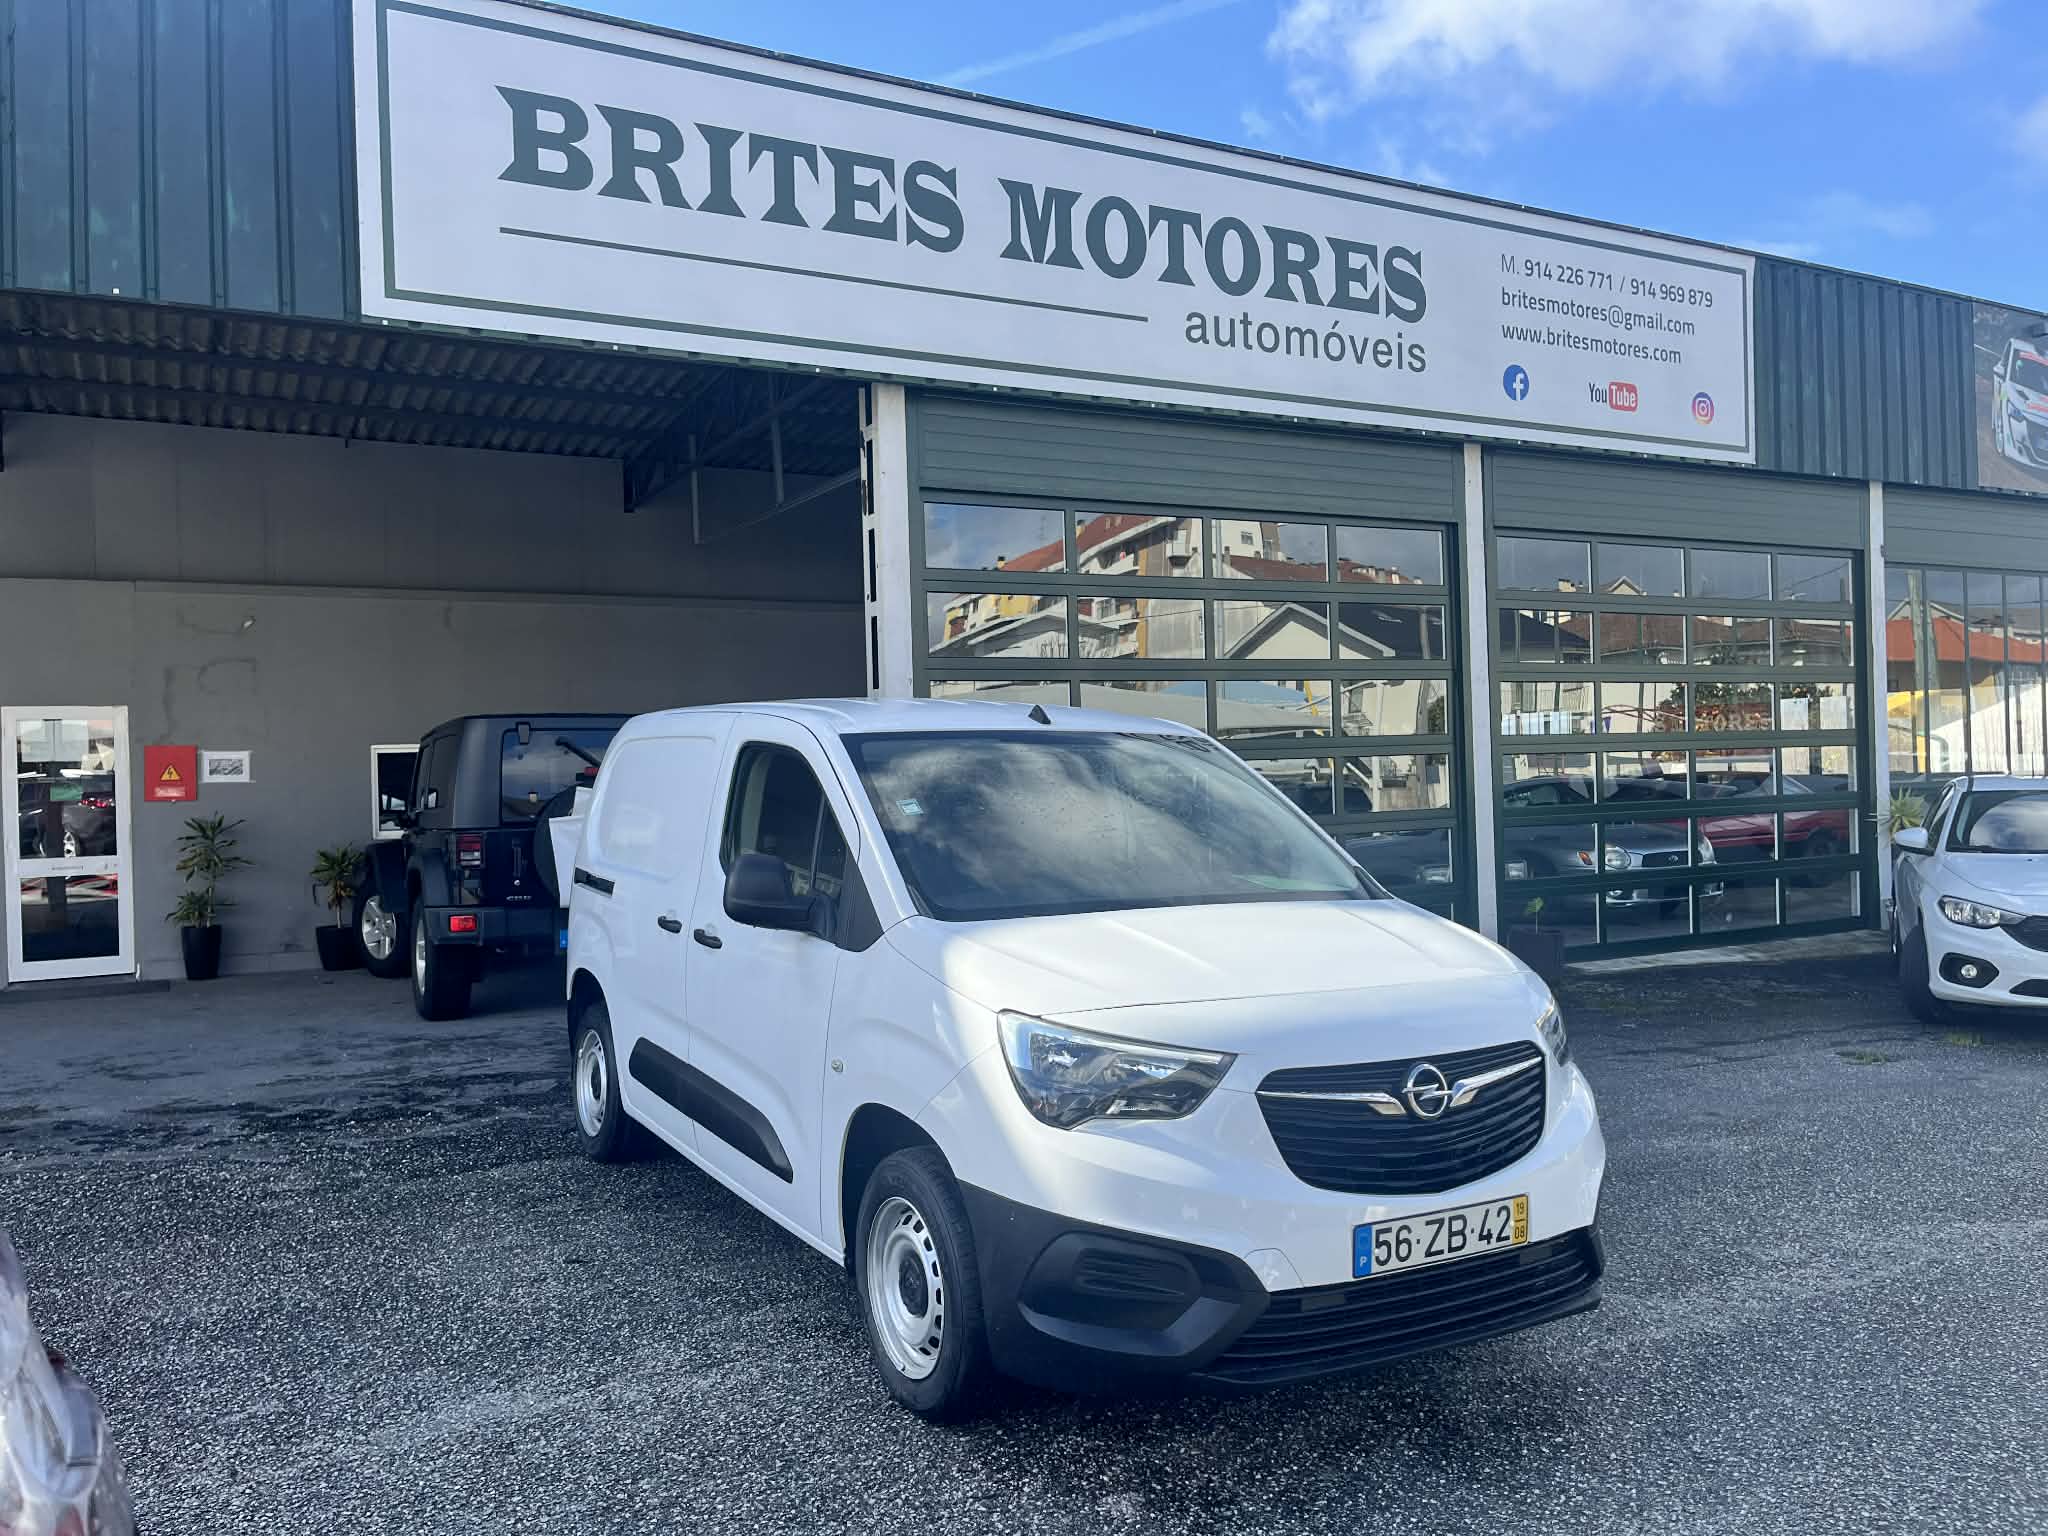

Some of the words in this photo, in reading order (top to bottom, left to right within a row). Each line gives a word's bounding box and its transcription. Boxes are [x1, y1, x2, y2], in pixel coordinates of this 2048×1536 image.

[494, 85, 965, 254] BRITES
[997, 178, 1427, 324] MOTORES
[1501, 253, 1520, 275] M.
[1524, 258, 1553, 281] 914
[1556, 264, 1584, 286] 226
[1587, 270, 1613, 292] 771
[1619, 276, 1626, 293] /
[1630, 278, 1657, 299] 914
[1659, 283, 1685, 304] 969
[1688, 288, 1713, 308] 879
[1501, 285, 1695, 336] britesmotores@gmail.com
[1185, 311, 1427, 373] automóveis
[1501, 323, 1682, 364] www.britesmotores.com
[1515, 1202, 1525, 1216] 19
[1514, 1225, 1525, 1240] 08
[1359, 1255, 1368, 1268] P
